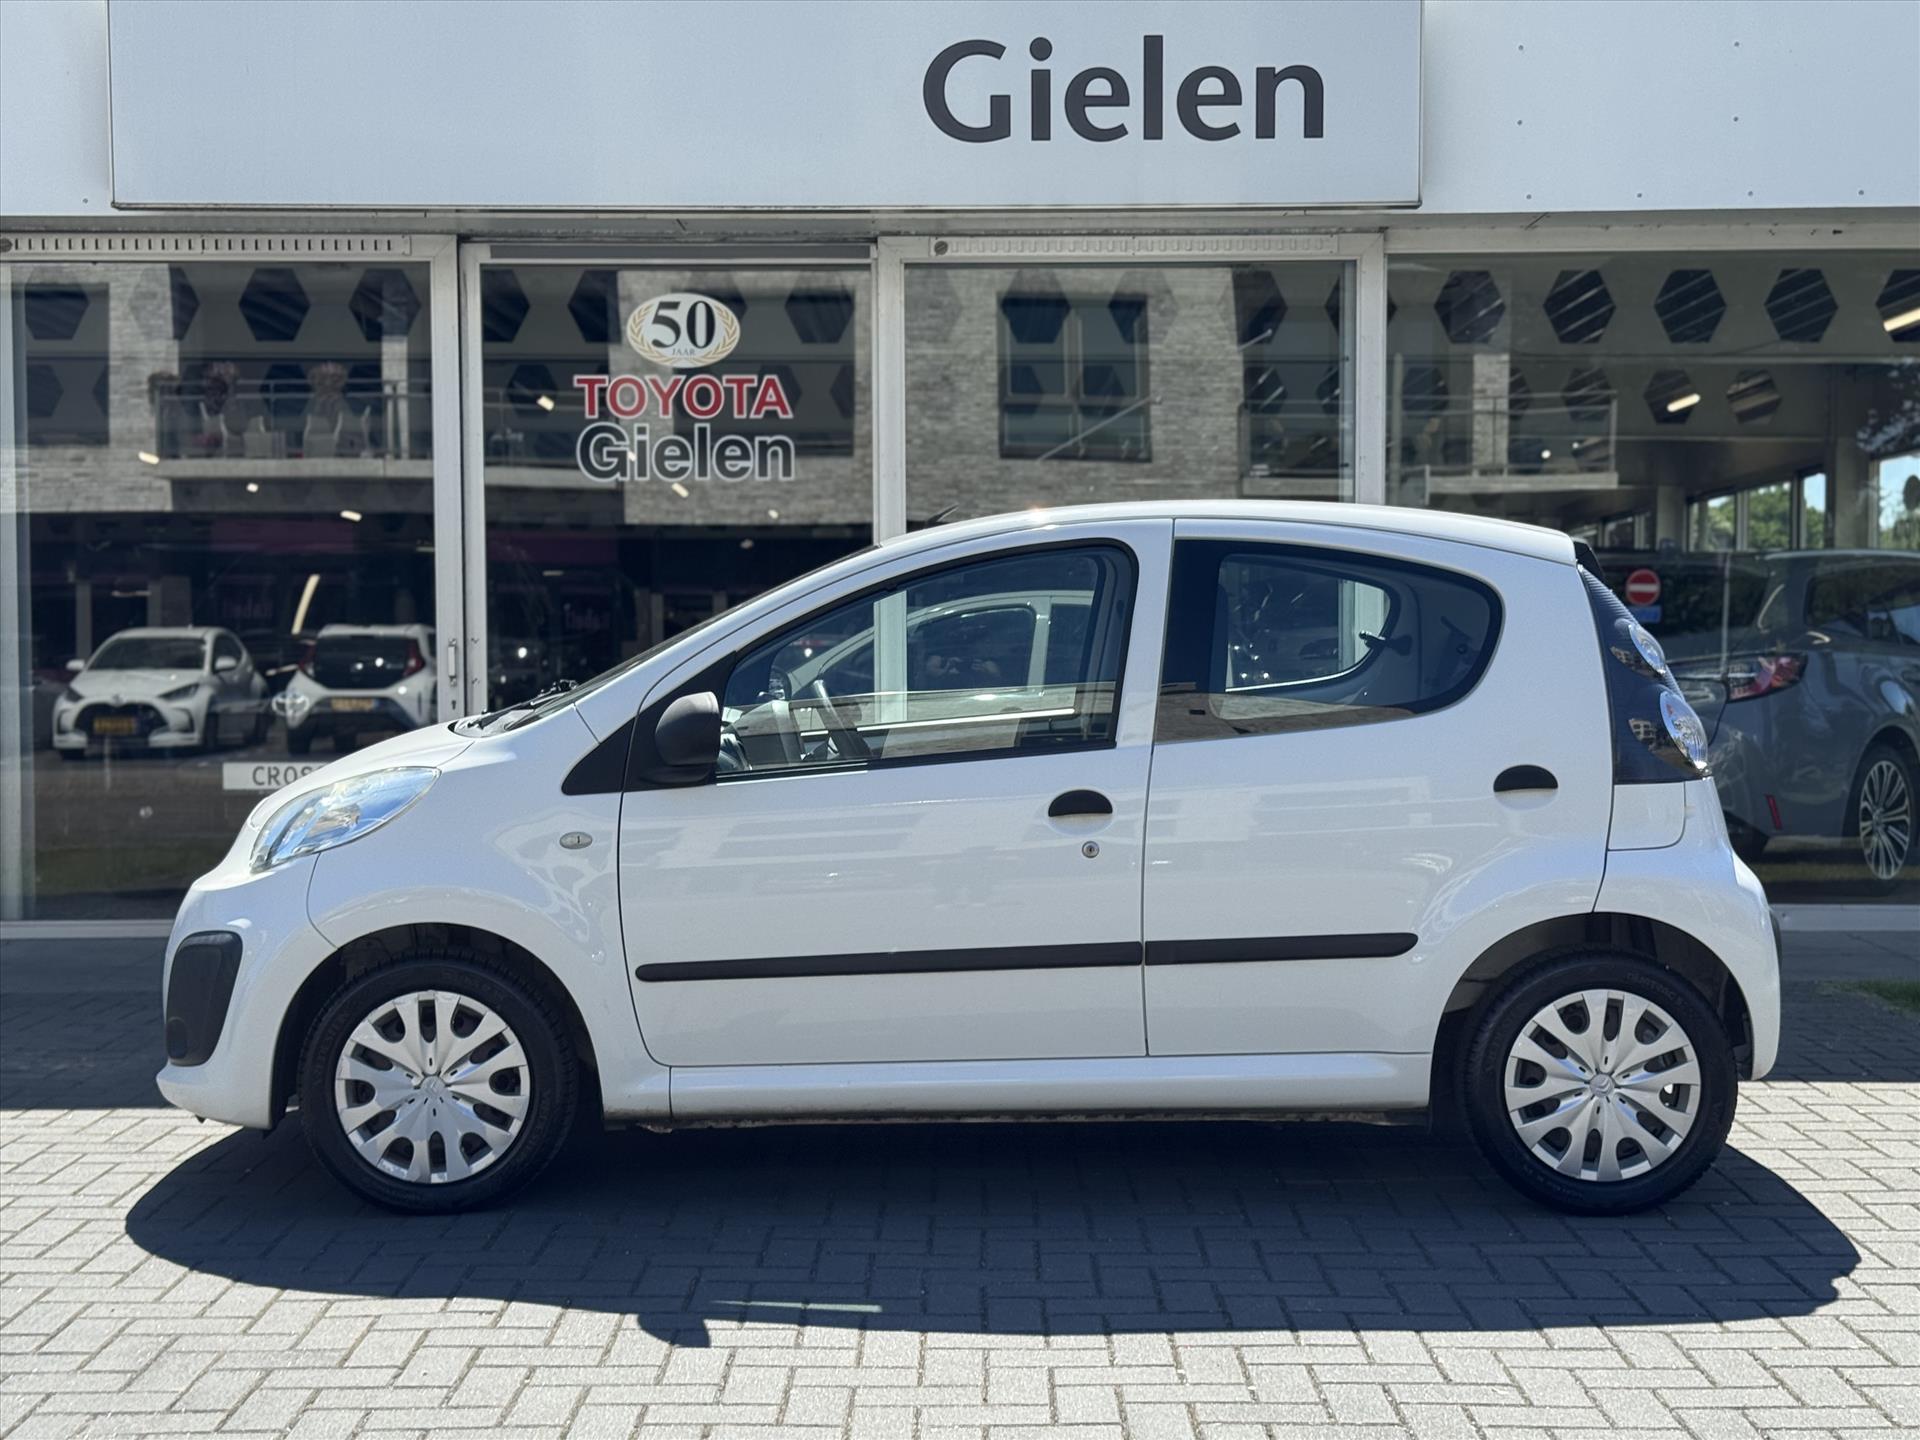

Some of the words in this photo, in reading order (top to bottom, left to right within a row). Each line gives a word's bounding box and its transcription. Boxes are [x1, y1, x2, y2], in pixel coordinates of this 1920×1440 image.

[923, 35, 1324, 143] Gielen
[651, 300, 716, 349] 50
[672, 348, 696, 356] JAAR
[573, 374, 794, 419] TOYOTA
[576, 422, 796, 483] Gielen
